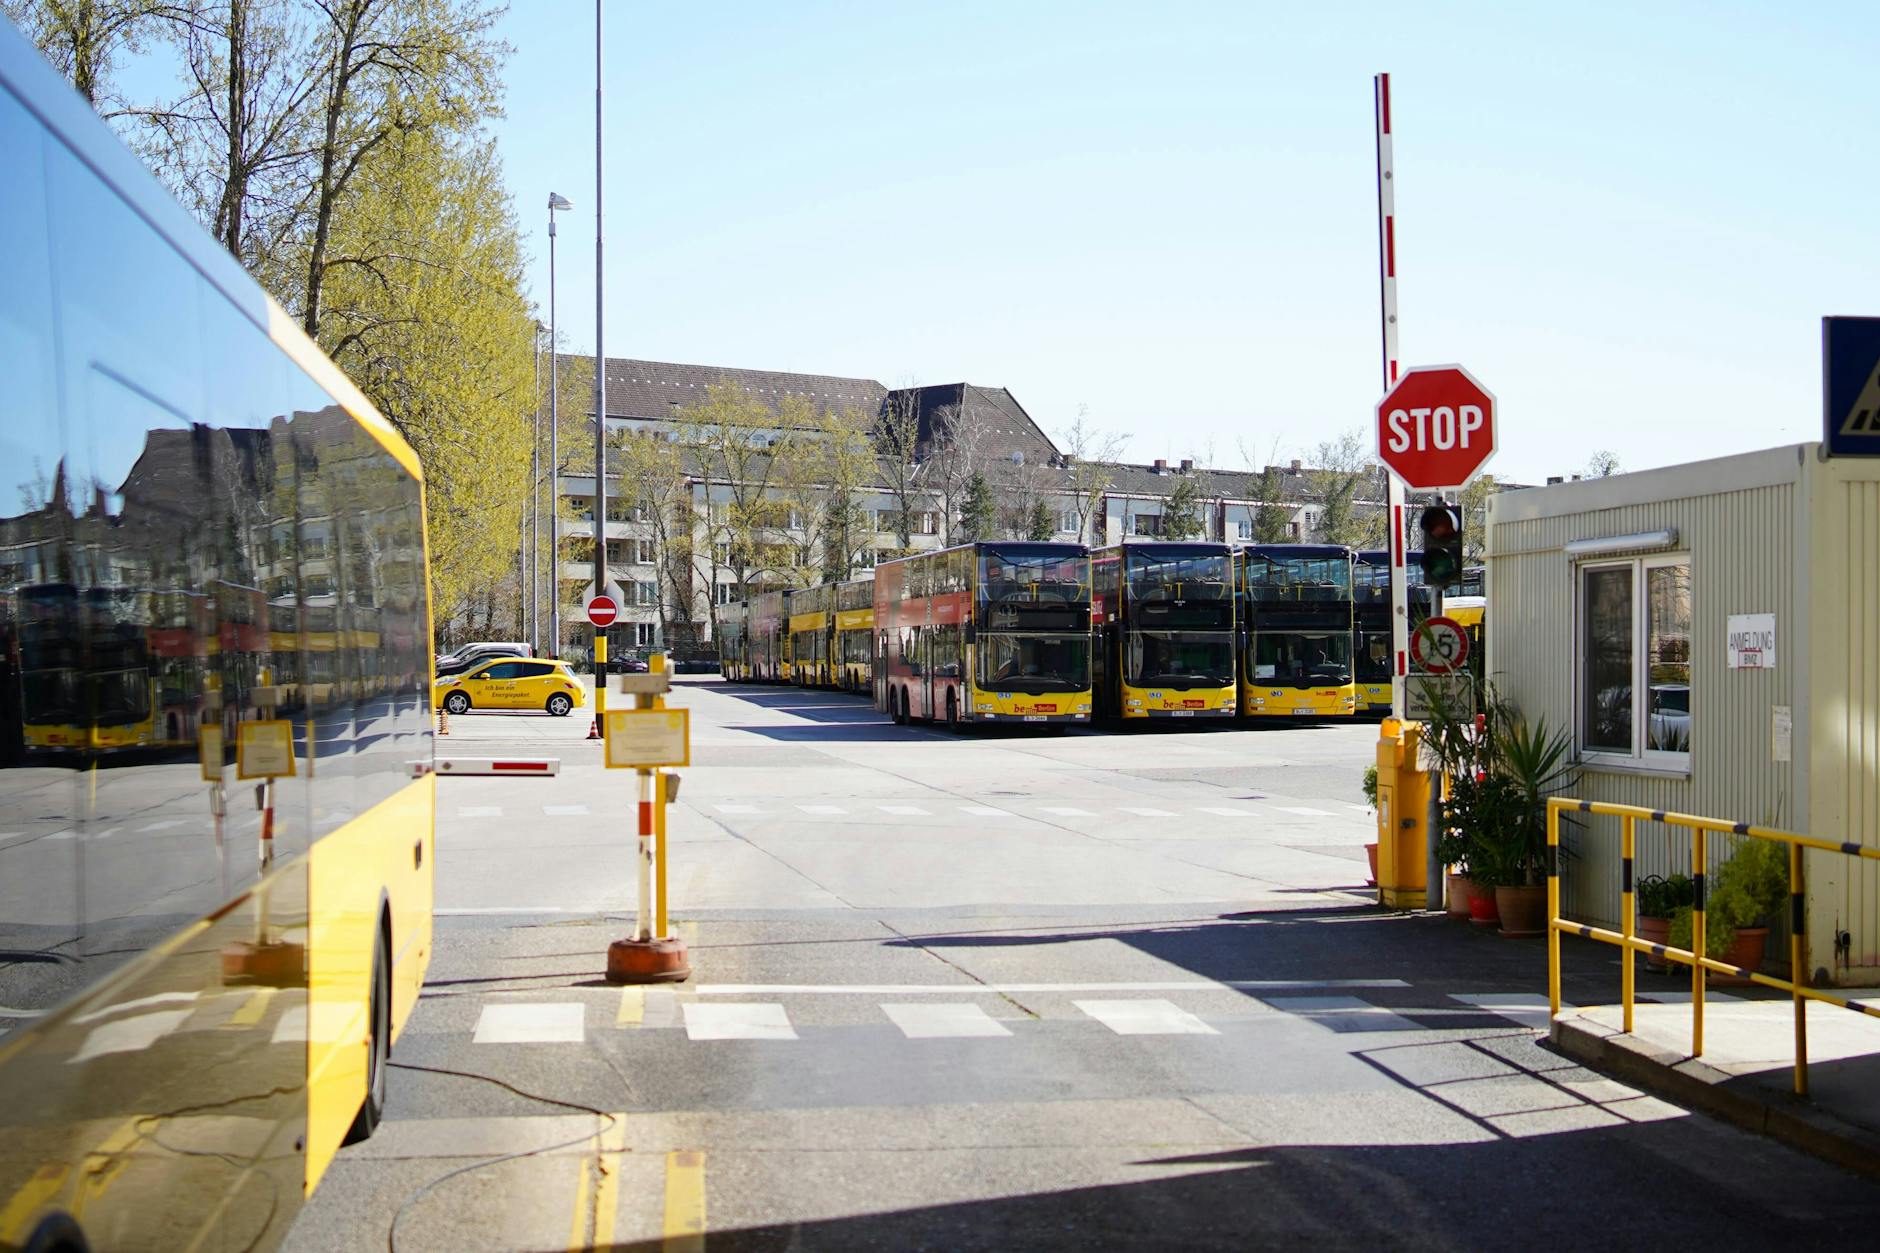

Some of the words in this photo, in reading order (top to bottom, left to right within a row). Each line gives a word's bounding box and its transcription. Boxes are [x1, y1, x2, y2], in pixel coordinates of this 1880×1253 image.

[1388, 405, 1483, 454] STOP
[1729, 631, 1773, 651] ANMELDUNG
[1743, 653, 1758, 665] BMZ
